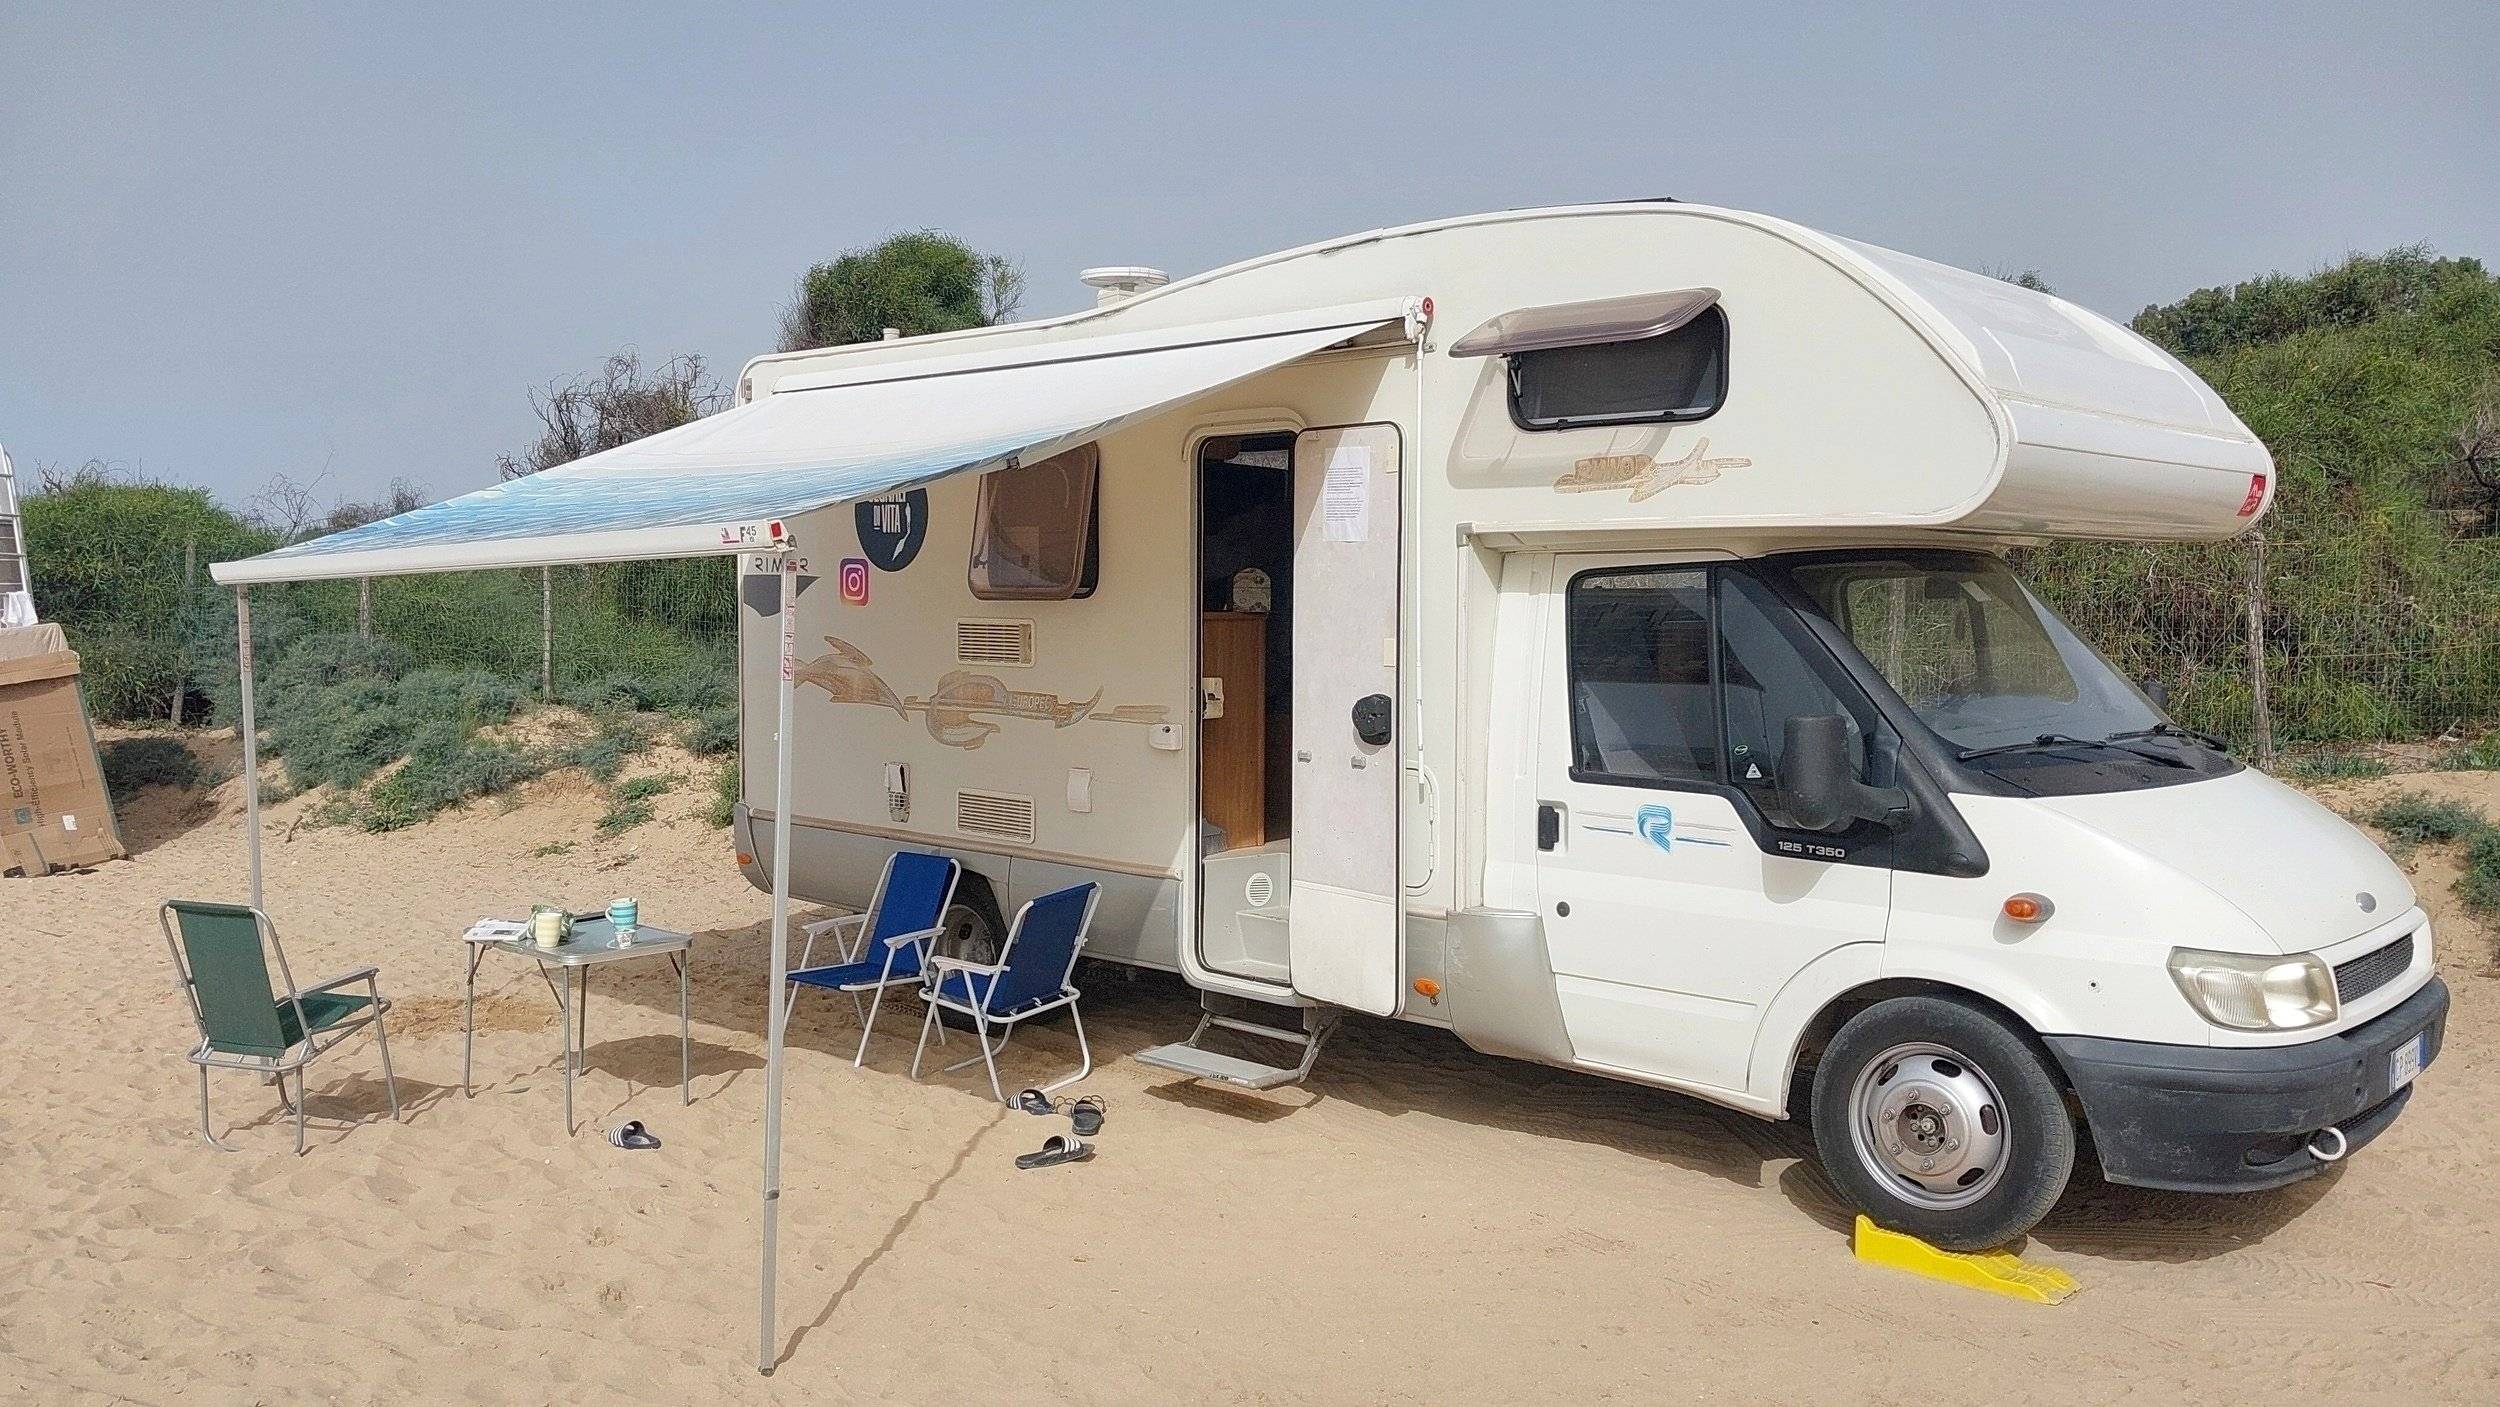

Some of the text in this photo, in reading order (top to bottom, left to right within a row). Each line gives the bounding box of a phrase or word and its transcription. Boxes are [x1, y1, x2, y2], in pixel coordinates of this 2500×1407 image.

[881, 504, 901, 533] VITA
[740, 525, 757, 543] F45
[755, 557, 809, 573] RIMR
[0, 727, 24, 800] ECO-WORTHY
[1778, 841, 1846, 858] 125 T350
